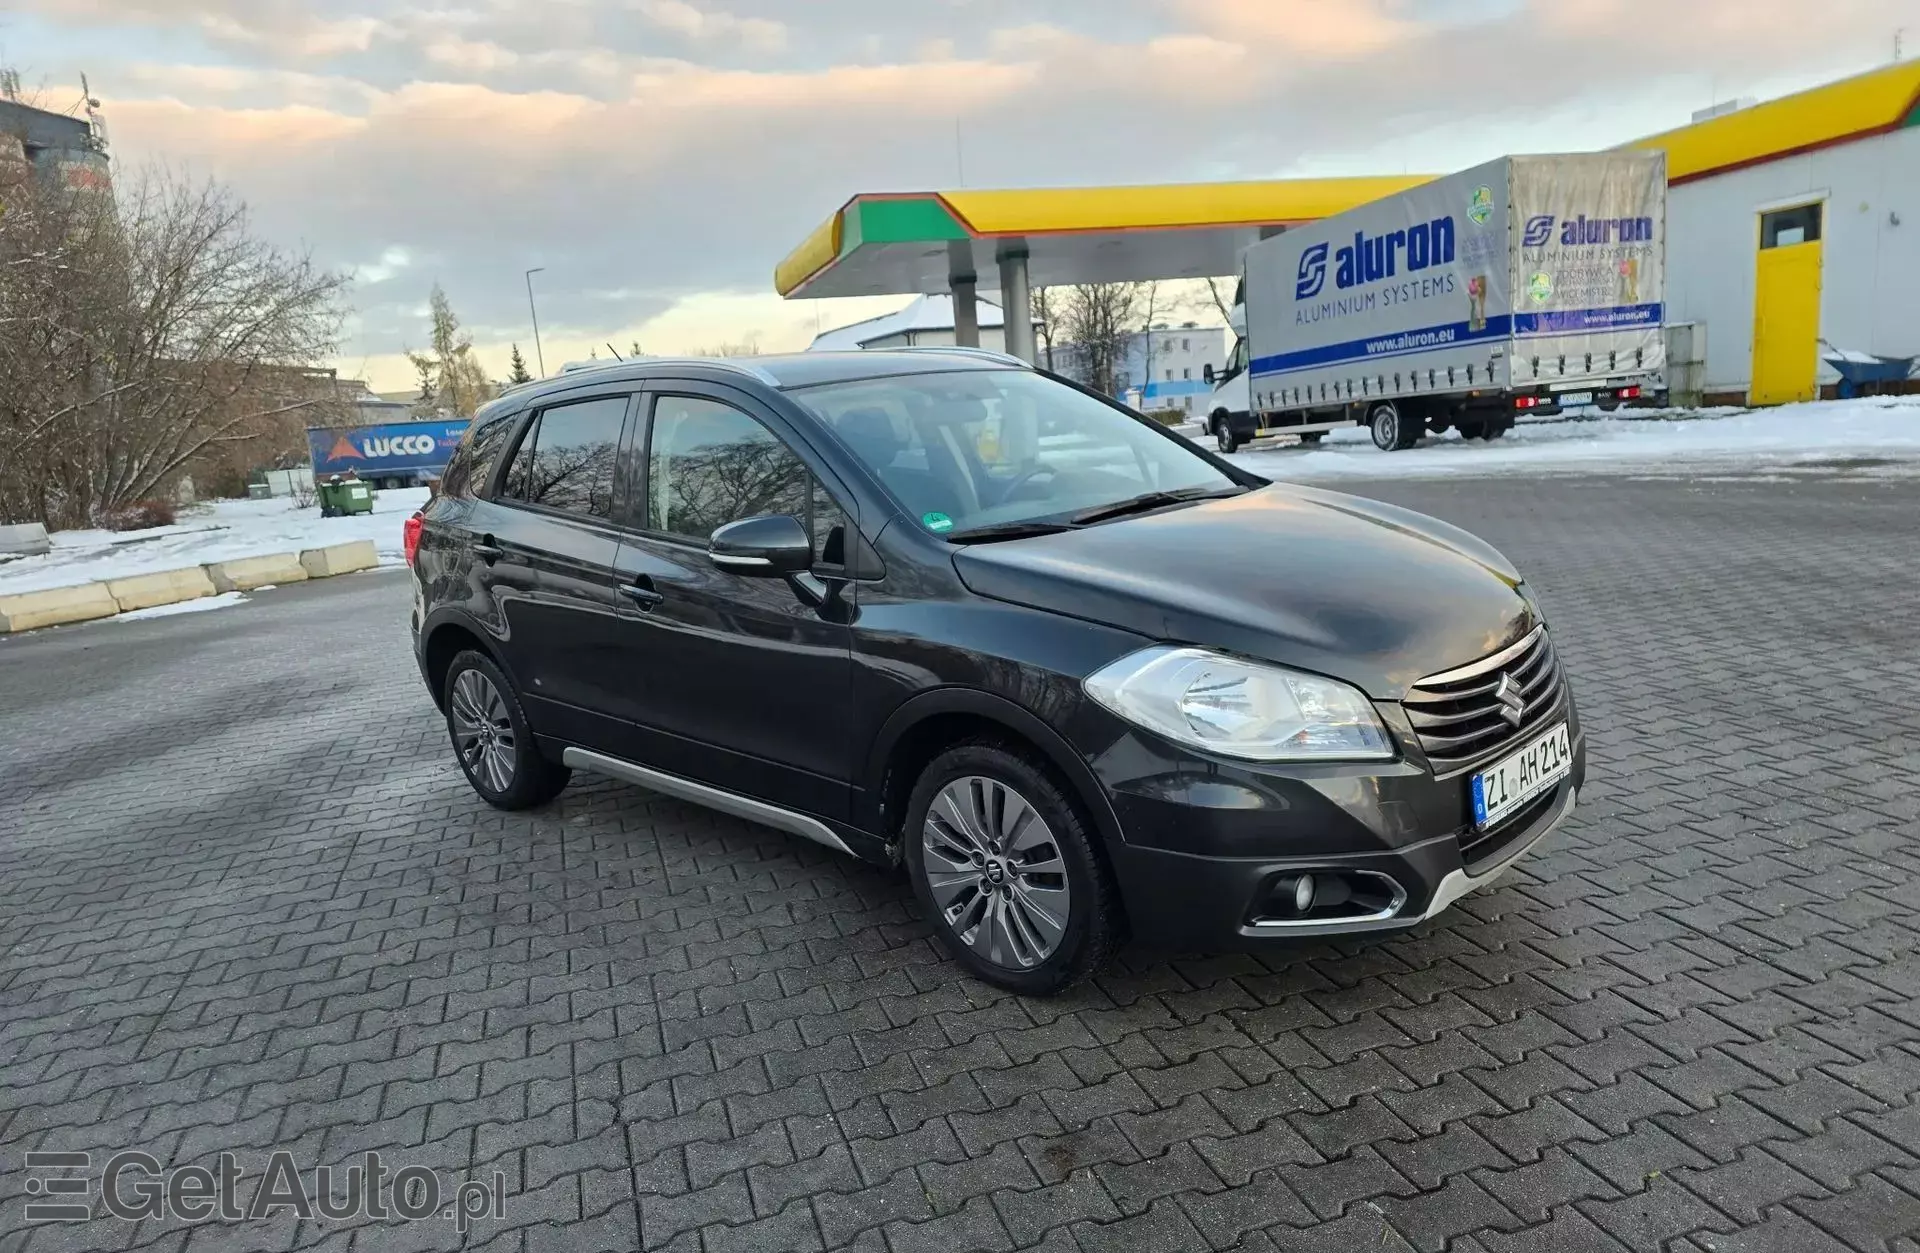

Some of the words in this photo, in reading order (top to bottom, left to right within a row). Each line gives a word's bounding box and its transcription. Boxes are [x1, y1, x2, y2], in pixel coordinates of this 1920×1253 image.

[1560, 214, 1653, 246] aluron
[1335, 215, 1455, 290] aluron
[1522, 250, 1595, 264] ALUMINIUM
[1600, 247, 1653, 259] SYSTEMS
[1296, 292, 1376, 326] ALUMINIUM
[1383, 273, 1455, 307] SYSTEMS
[1584, 310, 1650, 324] www.aluron.eu
[1366, 328, 1455, 354] www.aluron.eu
[362, 434, 436, 457] LUCCO
[1485, 768, 1508, 811] ZI
